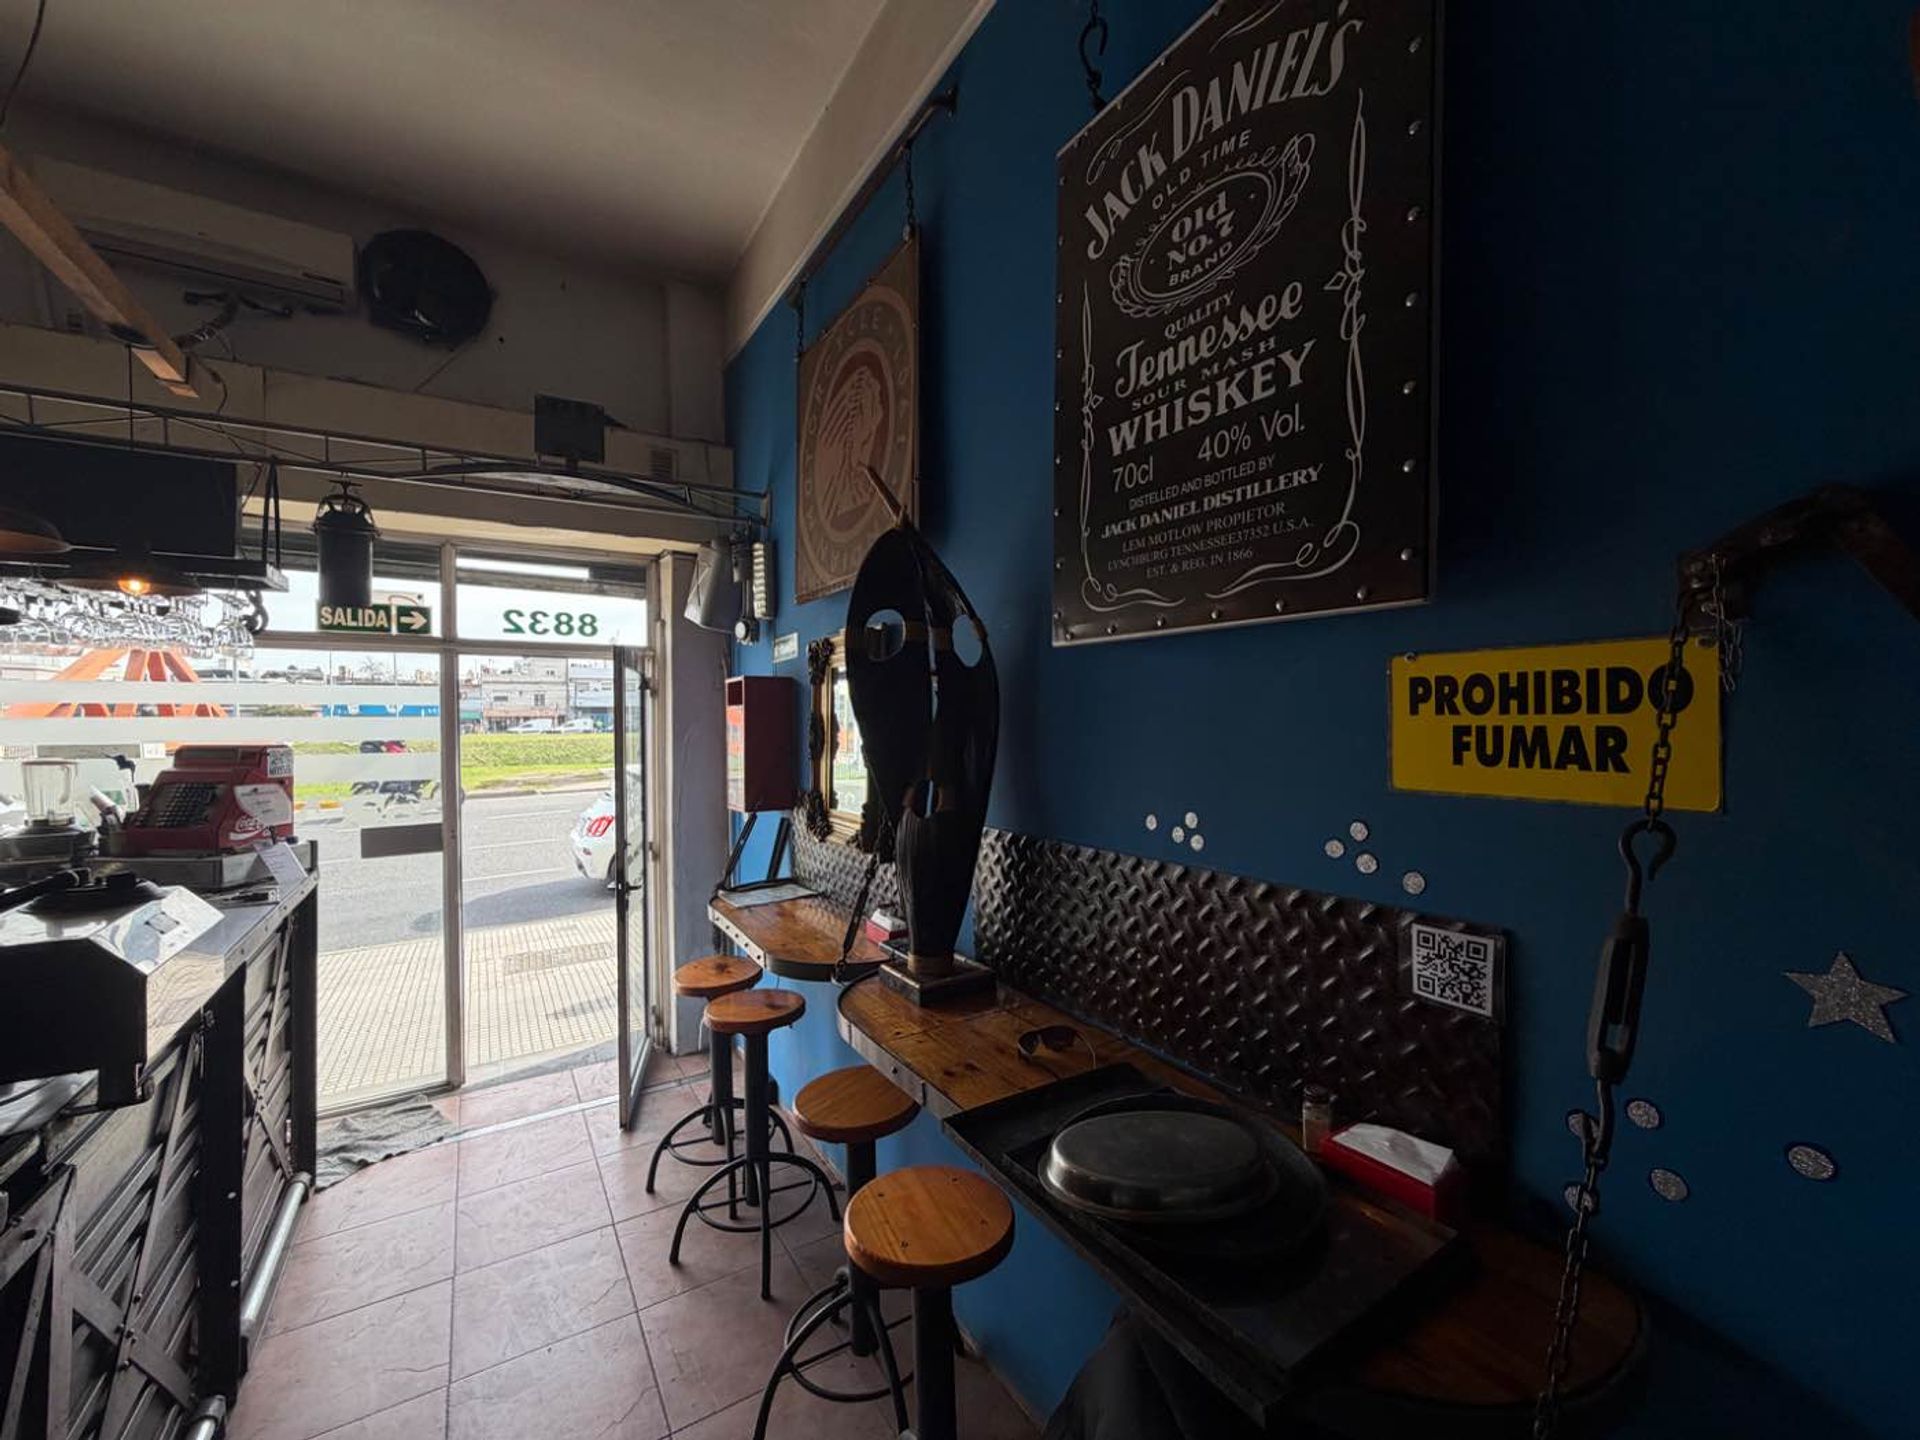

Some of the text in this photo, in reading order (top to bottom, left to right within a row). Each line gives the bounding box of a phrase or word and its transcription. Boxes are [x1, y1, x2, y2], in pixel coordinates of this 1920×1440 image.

[1085, 131, 1168, 260] JACK
[1152, 129, 1252, 210] OLD TIME
[1171, 189, 1227, 243] Old
[1168, 241, 1233, 287] BRAND
[1115, 281, 1304, 399] Tennessee
[1164, 289, 1235, 340] QUALITY
[1108, 338, 1318, 457] WHISKEY
[1131, 336, 1277, 411] SOUR MASH
[1112, 402, 1306, 493] 70cl 40% Vol.
[1180, 477, 1202, 496] AND
[1203, 459, 1257, 488] BOTTLED
[1258, 453, 1277, 473] BY
[1101, 462, 1326, 540] JACK DANIEL DISTILLERY
[1122, 536, 1147, 553] LEM
[1149, 522, 1205, 548] MOTLOW
[1211, 552, 1224, 566] IN
[320, 605, 389, 628] SALIDA
[1408, 665, 1693, 716] PROHIBIDO
[1451, 725, 1631, 774] FUMAR
